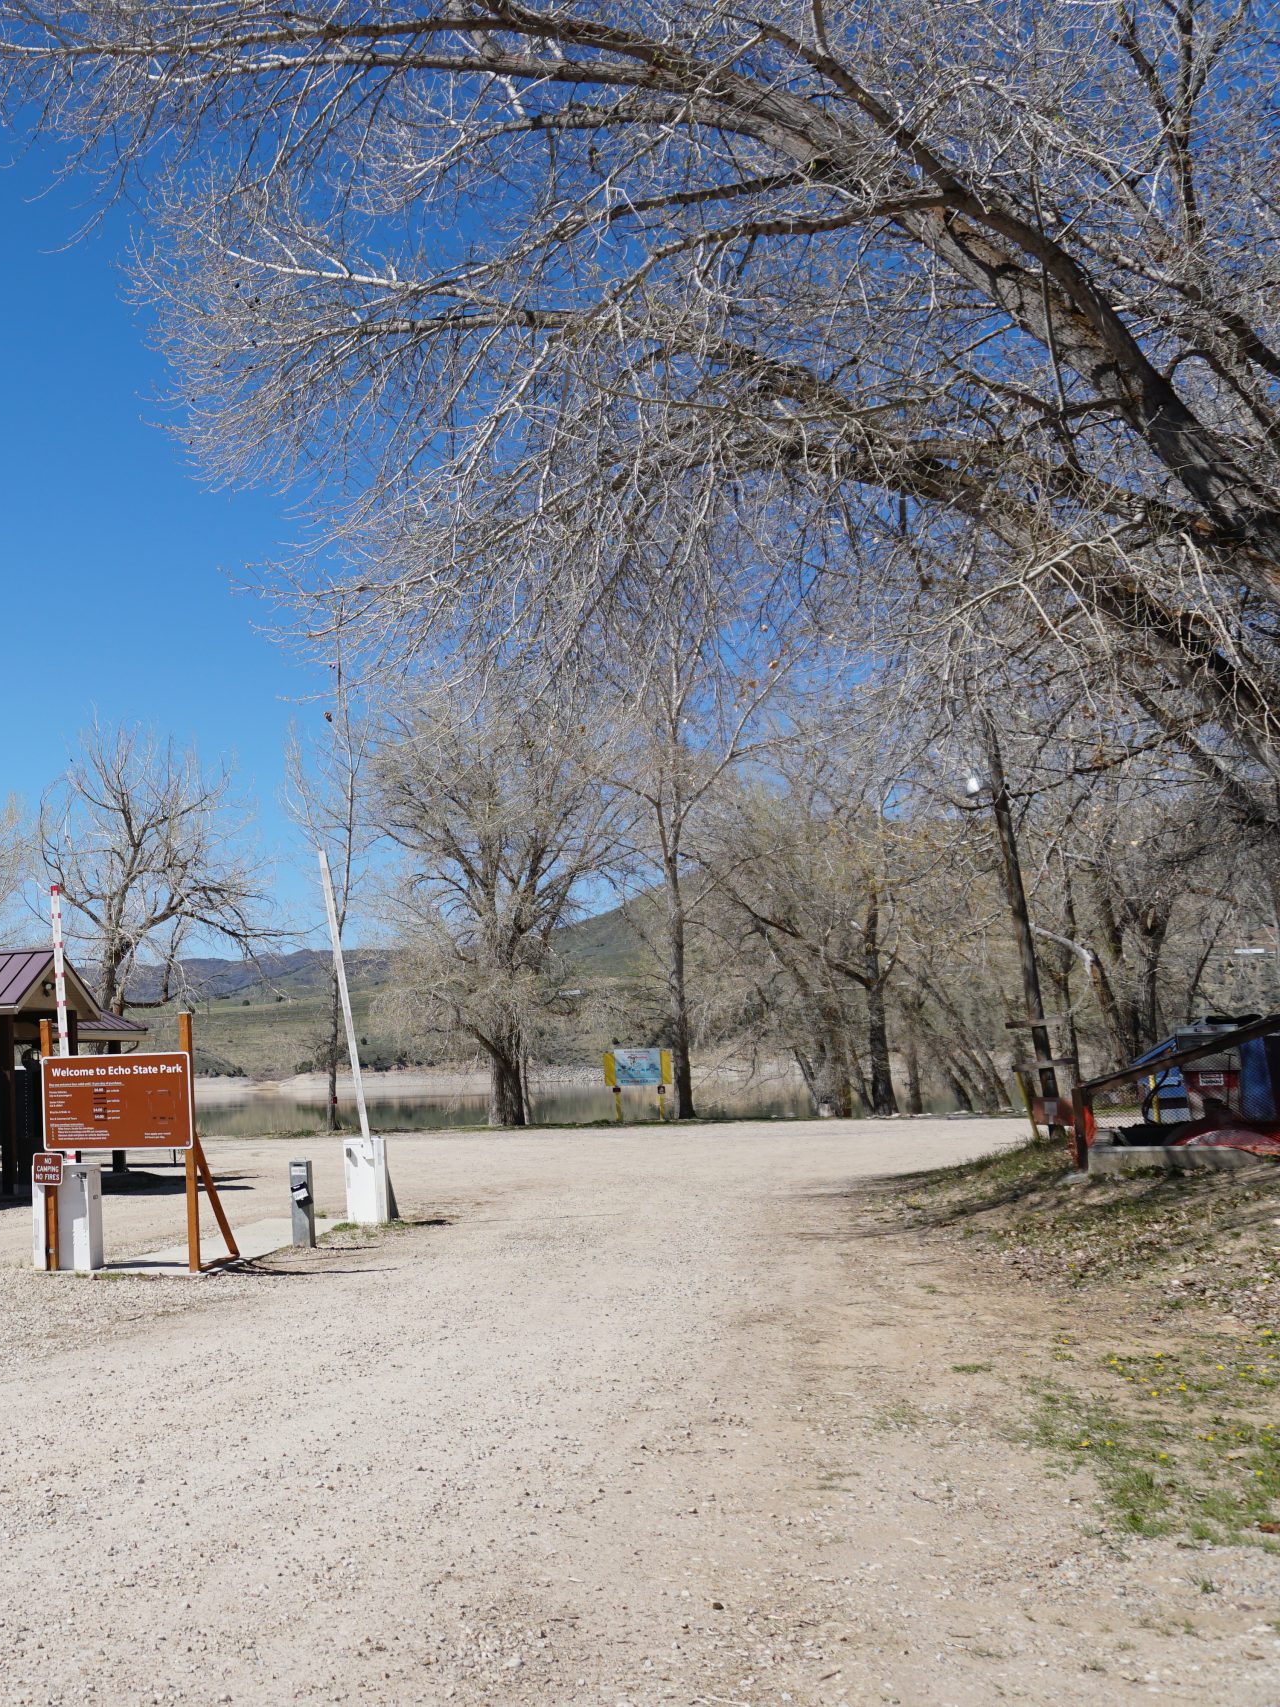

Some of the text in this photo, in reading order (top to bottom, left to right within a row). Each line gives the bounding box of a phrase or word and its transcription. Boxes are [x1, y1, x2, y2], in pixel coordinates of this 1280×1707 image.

[51, 1063, 183, 1077] Welcome to Echo State Park
[44, 1173, 60, 1181] FIRES
